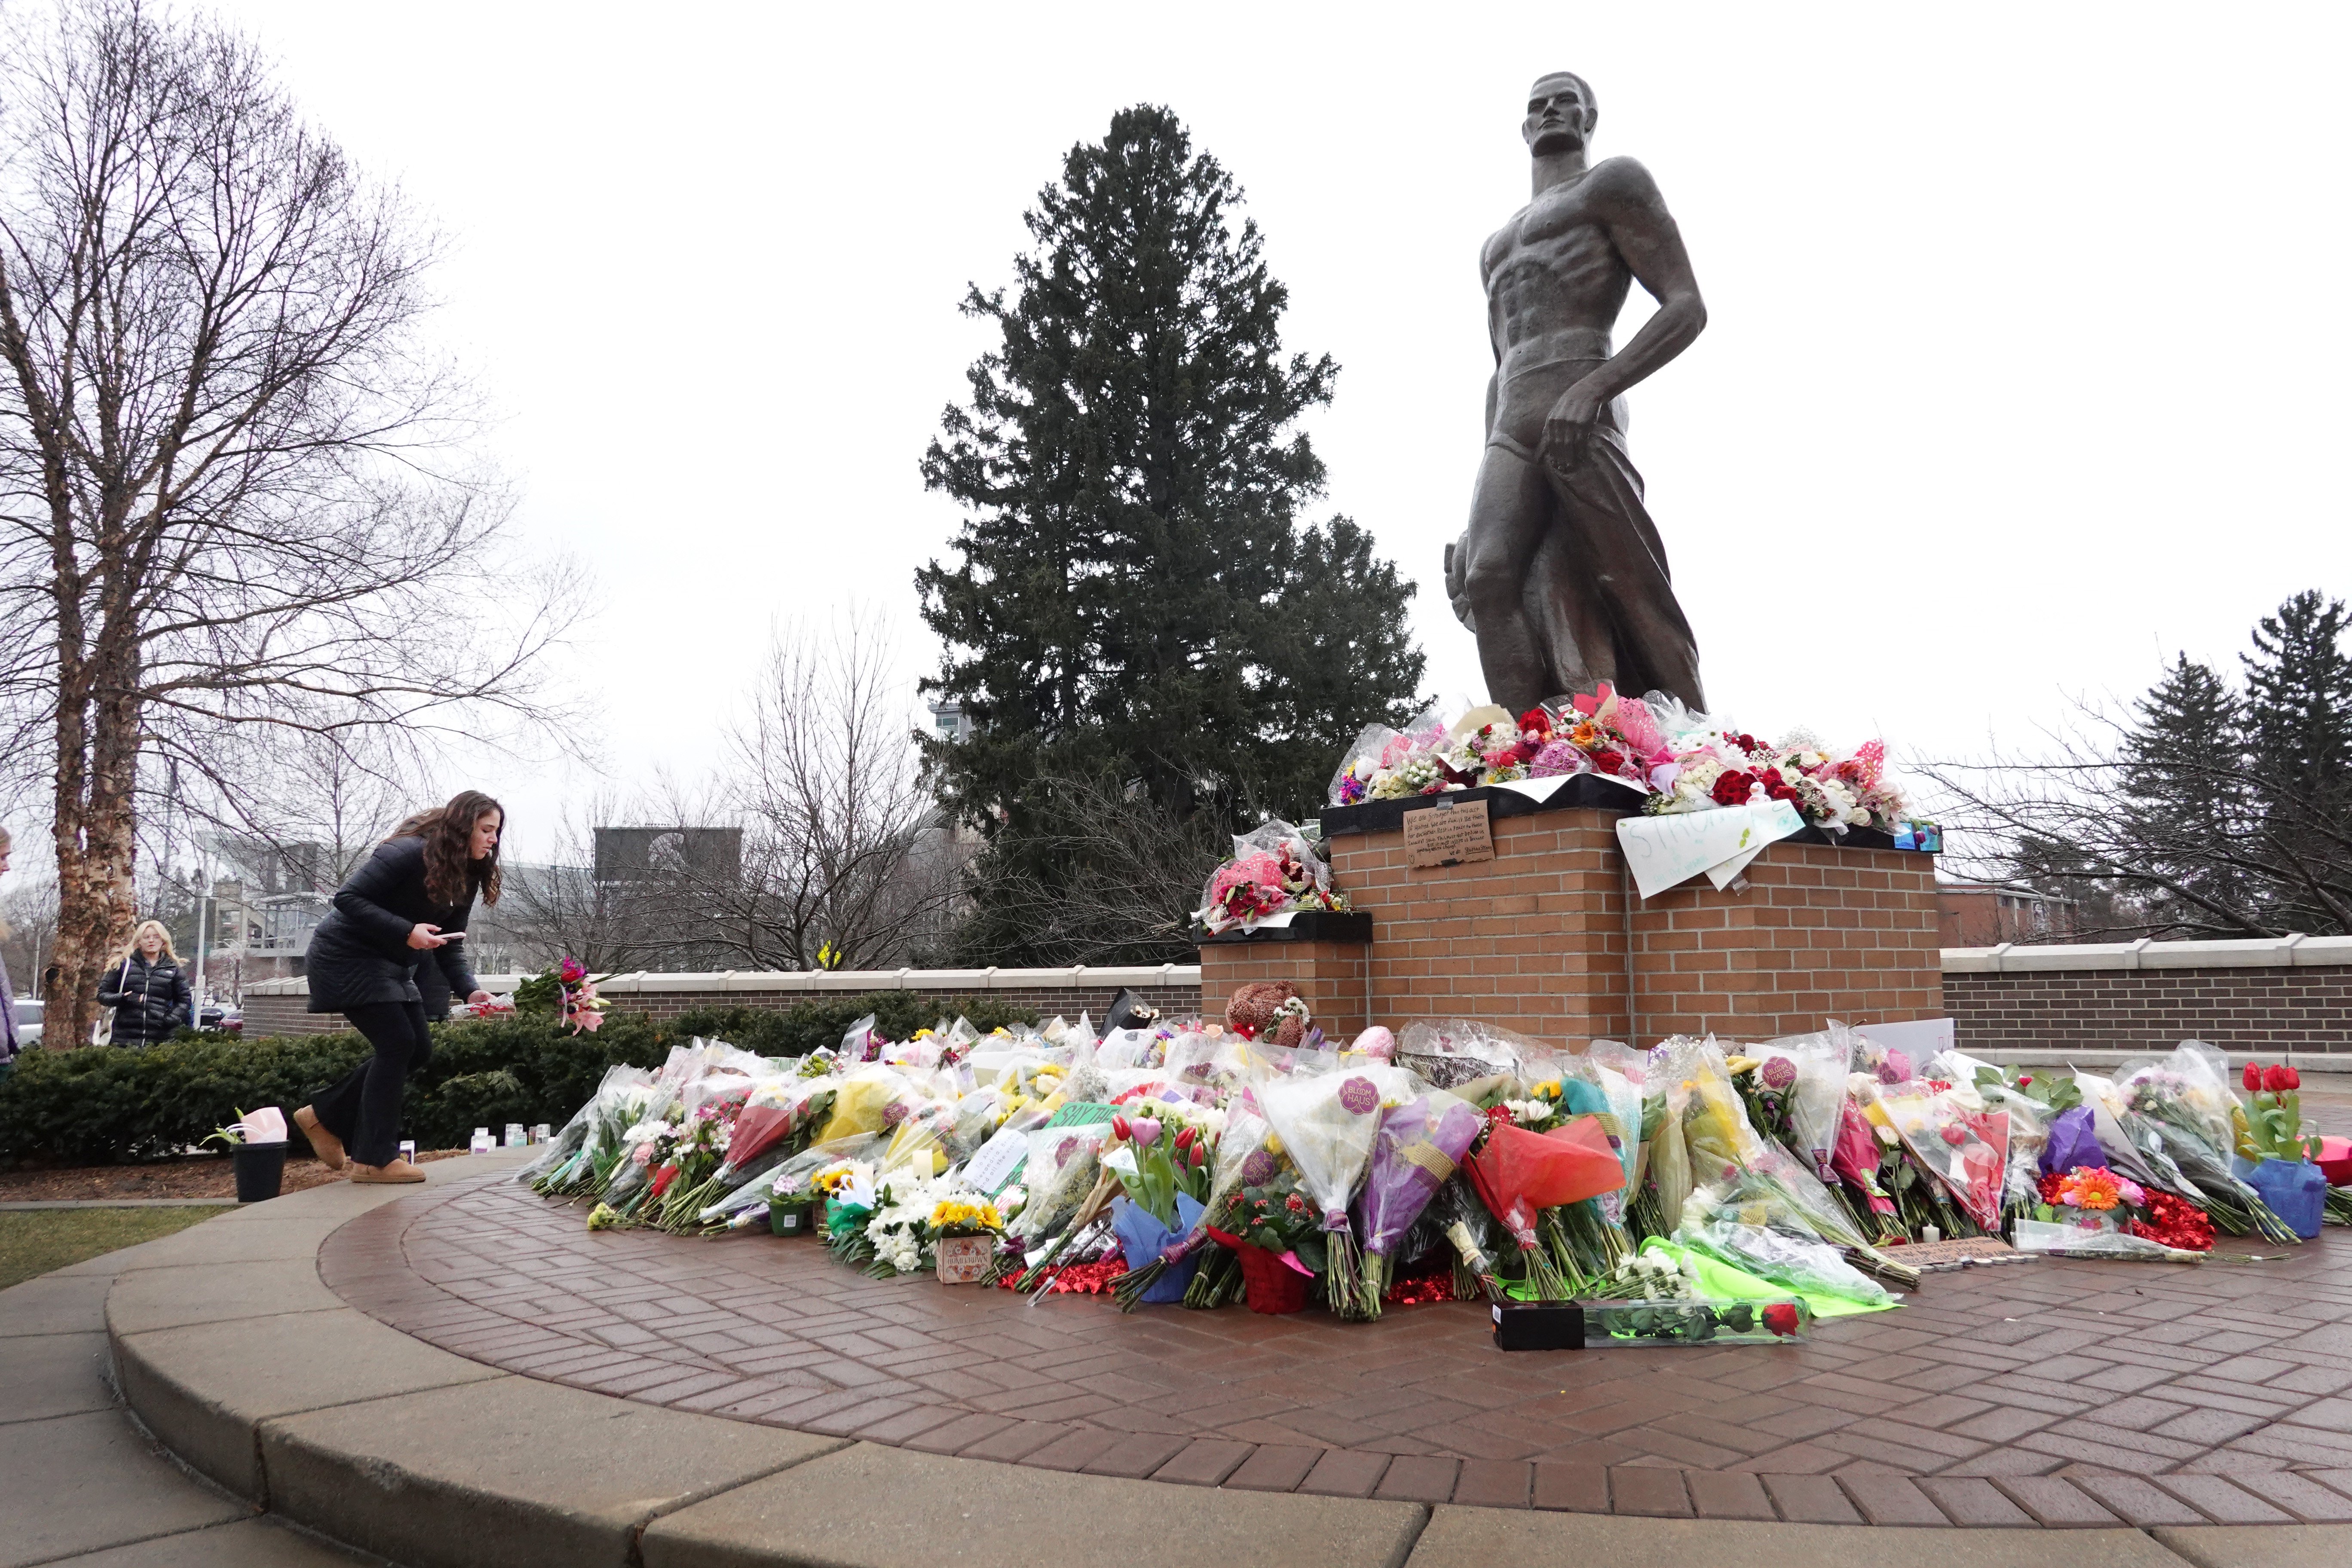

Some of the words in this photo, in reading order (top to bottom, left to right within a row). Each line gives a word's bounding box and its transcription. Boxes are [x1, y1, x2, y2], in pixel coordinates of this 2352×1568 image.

[1406, 816, 1417, 825] We
[1767, 1063, 1788, 1075] BLOOM
[1770, 1070, 1792, 1082] HAUS
[1348, 1086, 1371, 1097] BLOOM
[1347, 1094, 1370, 1106] HAUS
[1053, 1105, 1095, 1127] SAY
[974, 1150, 1002, 1183] Alexandria,
[980, 1177, 989, 1189] and
[997, 1155, 1006, 1166] the
[1249, 1162, 1264, 1181] HAUS
[1253, 1156, 1270, 1174] BLOOM
